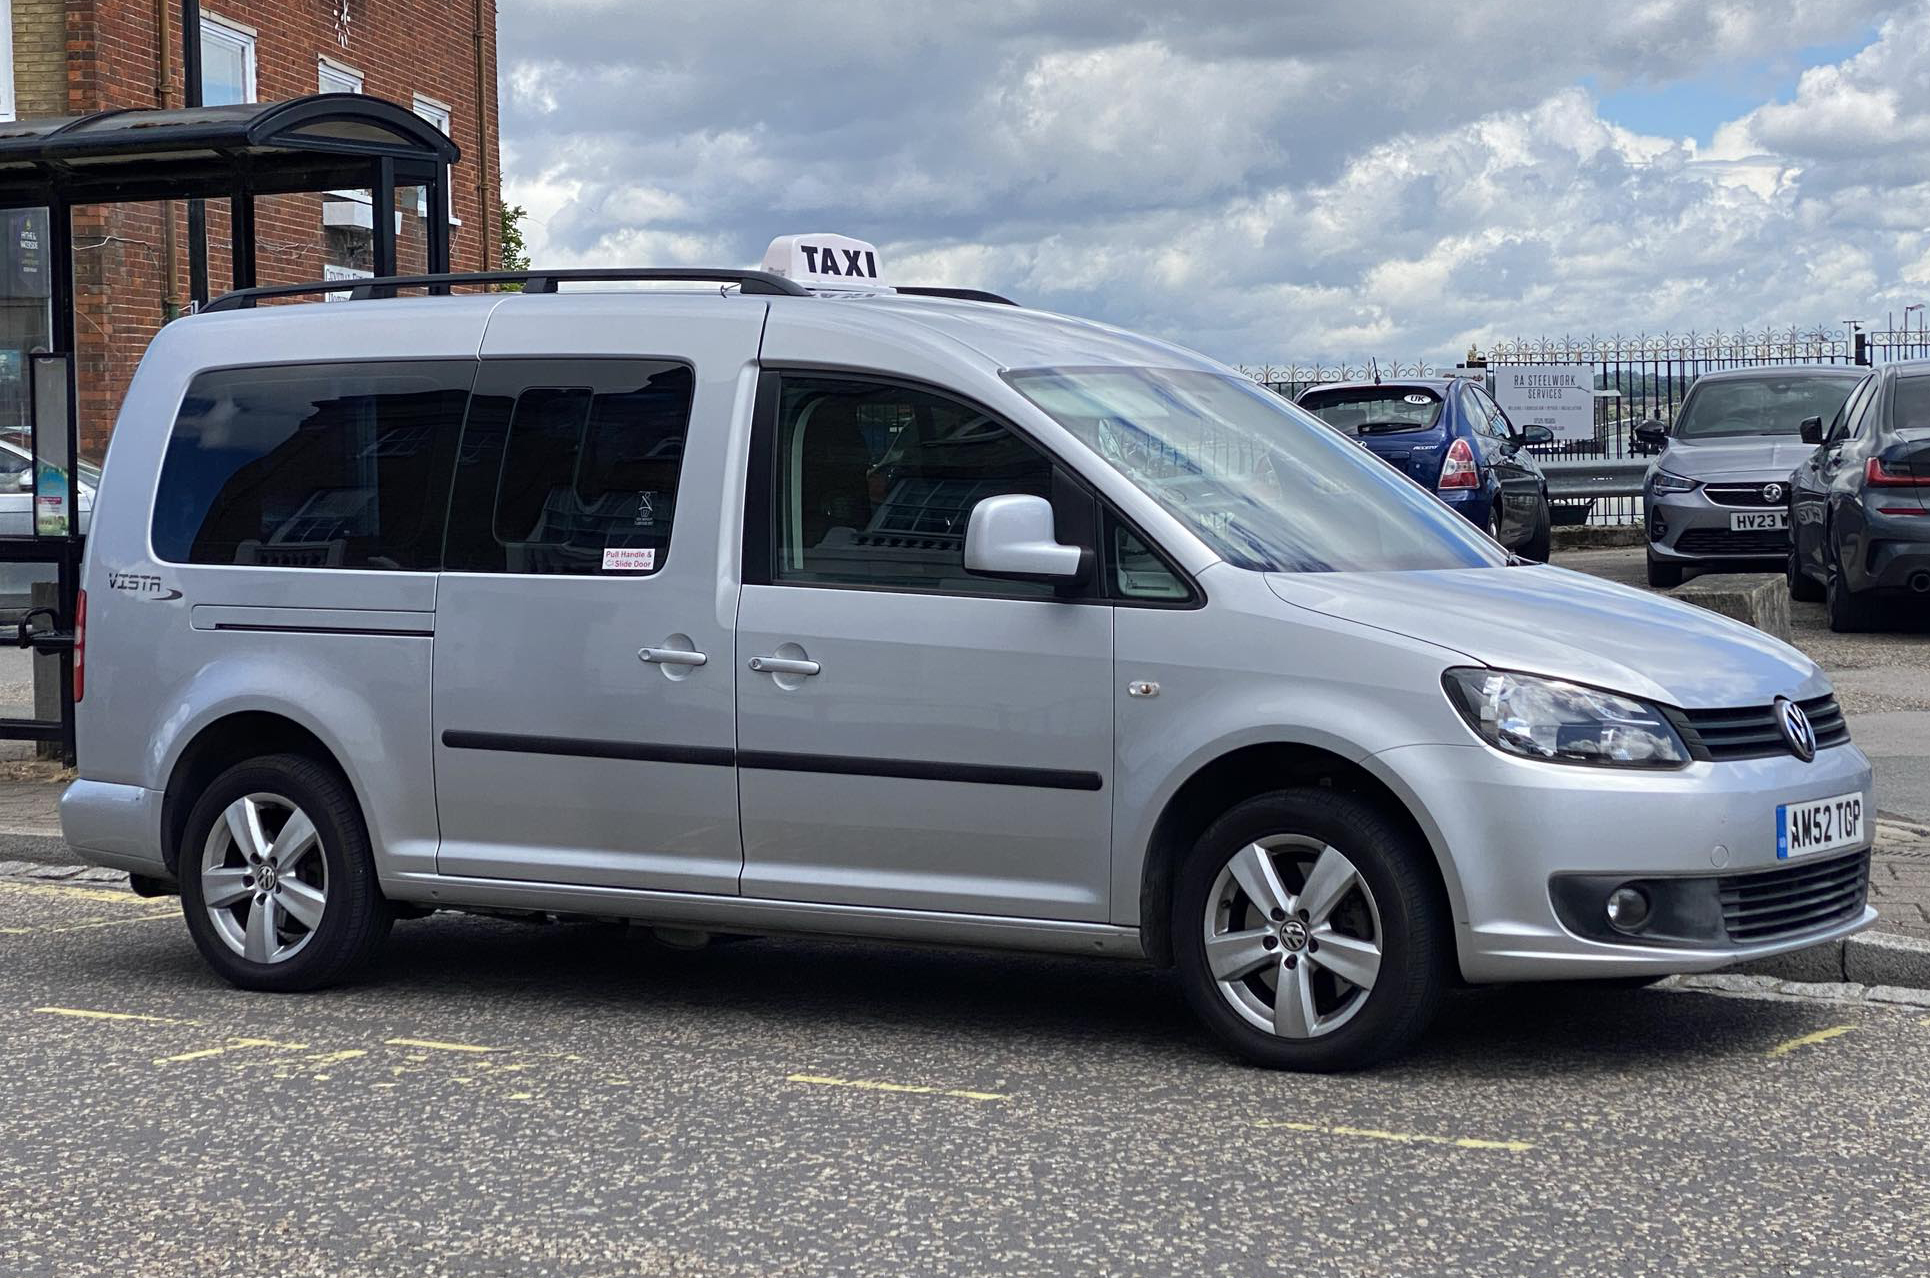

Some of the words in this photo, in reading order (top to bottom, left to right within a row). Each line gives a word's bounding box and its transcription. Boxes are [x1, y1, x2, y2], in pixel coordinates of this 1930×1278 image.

[801, 245, 877, 278] TAXI
[1514, 375, 1524, 386] RA
[1528, 375, 1576, 386] STEELWORK
[1528, 389, 1562, 399] SERVICES
[1736, 515, 1776, 529] HV23
[614, 560, 632, 568] Slide
[634, 560, 651, 568] Door
[109, 572, 161, 592] VISTA
[1791, 805, 1832, 849] AM52
[1836, 799, 1861, 840] TGP
